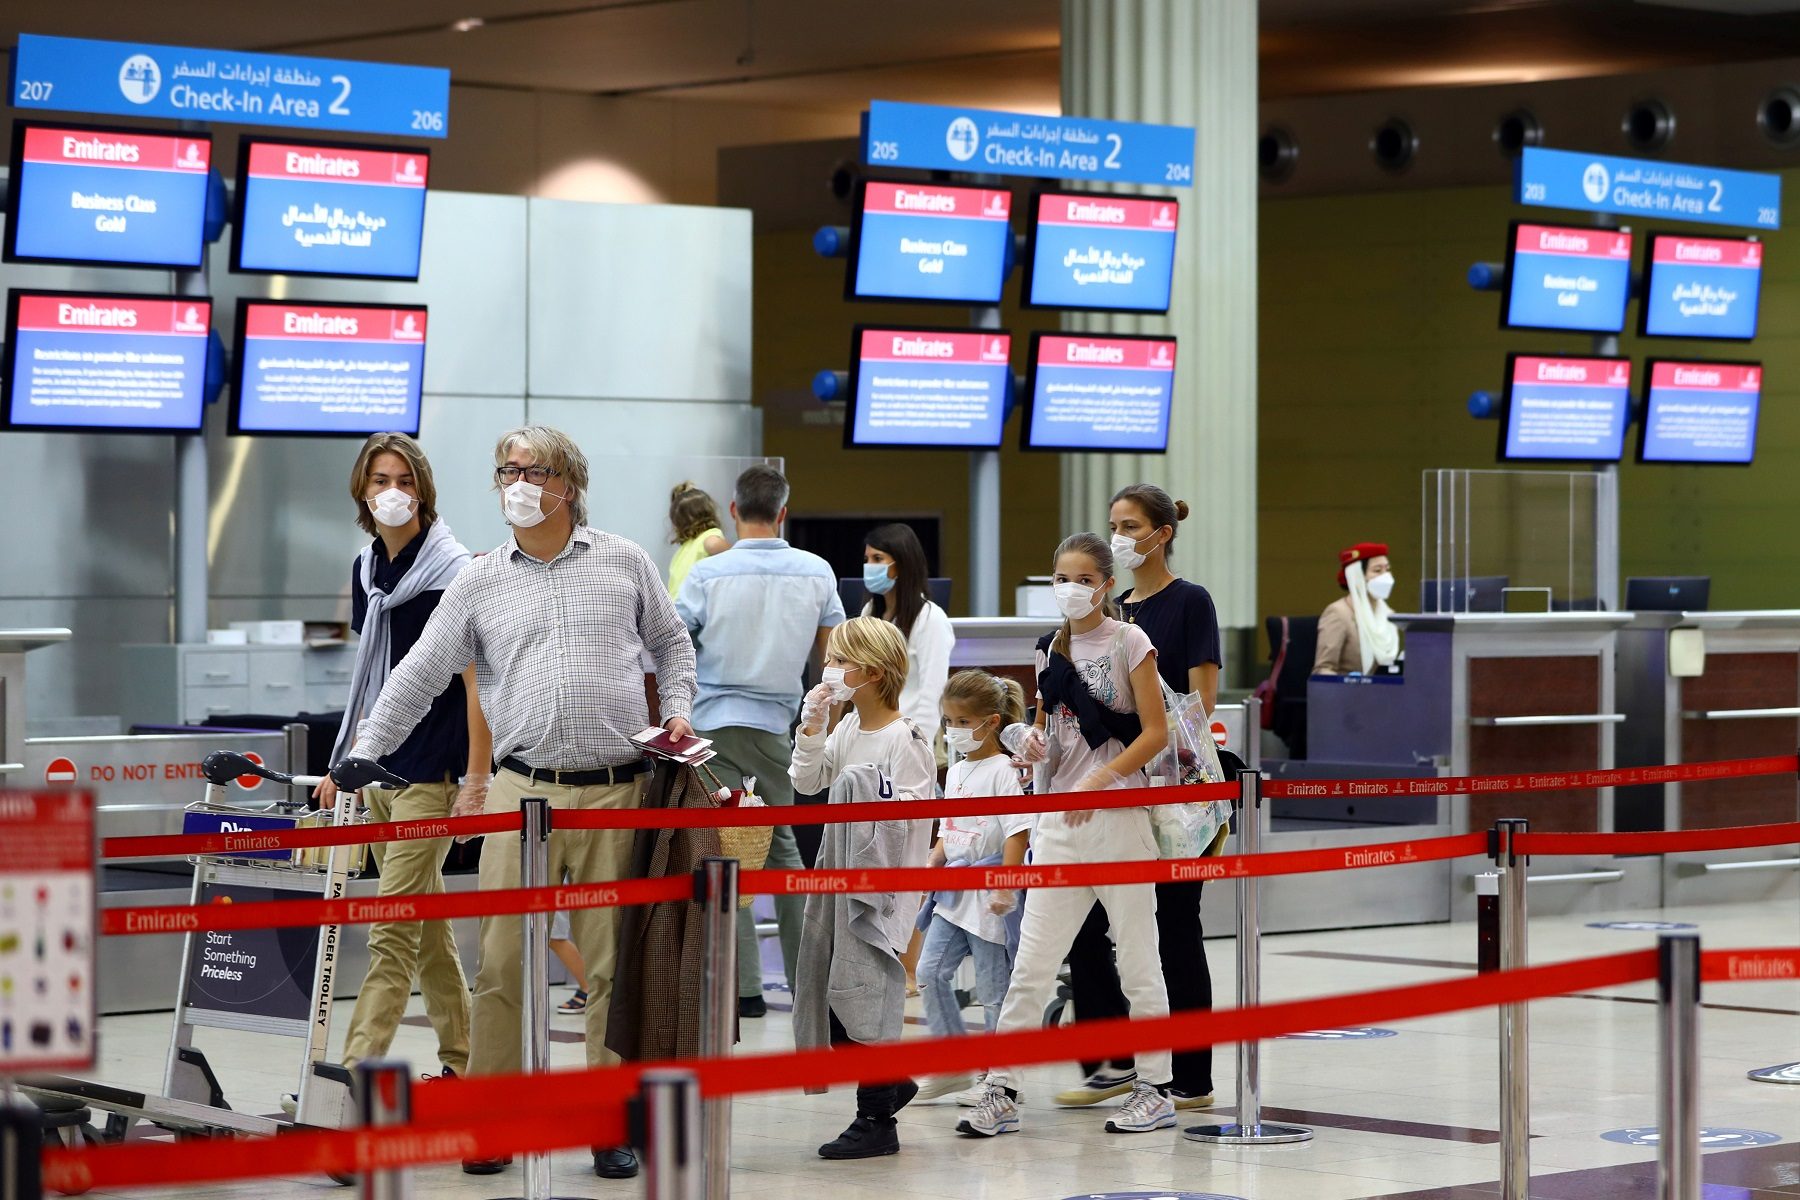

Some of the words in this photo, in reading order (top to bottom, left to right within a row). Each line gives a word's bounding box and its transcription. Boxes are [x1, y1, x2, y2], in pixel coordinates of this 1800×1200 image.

[172, 61, 216, 80] السفر
[219, 64, 270, 88] إجراءات
[274, 67, 320, 87] منطقة
[19, 80, 53, 101] 207
[169, 84, 263, 114] Check-In
[268, 93, 320, 118] Area
[327, 75, 352, 116] 2
[411, 110, 442, 131] 206
[986, 122, 1019, 138] السفر
[1062, 127, 1099, 145] منطقة
[62, 136, 139, 163] Emirates
[872, 141, 899, 160] 205
[984, 143, 1055, 169] Check-In
[1058, 151, 1098, 172] Area
[1103, 134, 1122, 169] 2
[285, 152, 360, 178] Emirates
[1165, 163, 1191, 181] 204
[71, 191, 123, 212] Business
[125, 194, 157, 214] Class
[894, 189, 955, 212] Emirates
[1524, 183, 1546, 201] 203
[1612, 186, 1671, 209] Check-In
[1673, 194, 1703, 214] Area
[1707, 178, 1723, 213] 2
[1067, 202, 1126, 223] Emirates
[1758, 207, 1777, 224] 202
[95, 215, 126, 233] Gold
[900, 238, 941, 255] Business
[1539, 231, 1588, 252] Emirates
[1675, 242, 1722, 261] Emirates
[918, 257, 943, 274] Gold
[58, 303, 138, 329] Emirates
[283, 312, 359, 337] Emirates
[892, 336, 954, 359] Emirates
[1066, 343, 1124, 363] Emirates
[1537, 362, 1587, 382] Emirates
[1673, 367, 1721, 386] Emirates
[90, 765, 115, 782] DO
[122, 764, 157, 781] NOT
[165, 763, 206, 780] ENTE
[1286, 783, 1328, 796] Emirates
[1348, 781, 1389, 796] Emirates
[1409, 780, 1449, 795] Emirates
[1471, 778, 1509, 791] Emirates
[1529, 775, 1566, 788] Emirates
[1586, 772, 1623, 786] Emirates
[1643, 769, 1679, 781] Emirates
[1697, 766, 1731, 777] Emirates
[225, 835, 280, 851] Emirates
[395, 823, 449, 839] Emirates
[1170, 862, 1225, 880] Emirates
[1344, 850, 1396, 867] Emirates
[785, 874, 848, 893] Emirates
[985, 870, 1043, 888] Emirates
[125, 910, 199, 931] Emirates
[348, 900, 417, 921] Emirates
[555, 888, 619, 908] Emirates
[322, 882, 342, 962] PANGER
[206, 930, 233, 946] Start
[203, 947, 257, 969] Something
[1728, 955, 1794, 979] Emirates
[200, 964, 243, 982] Priceless
[316, 967, 334, 1027] TROLLEY
